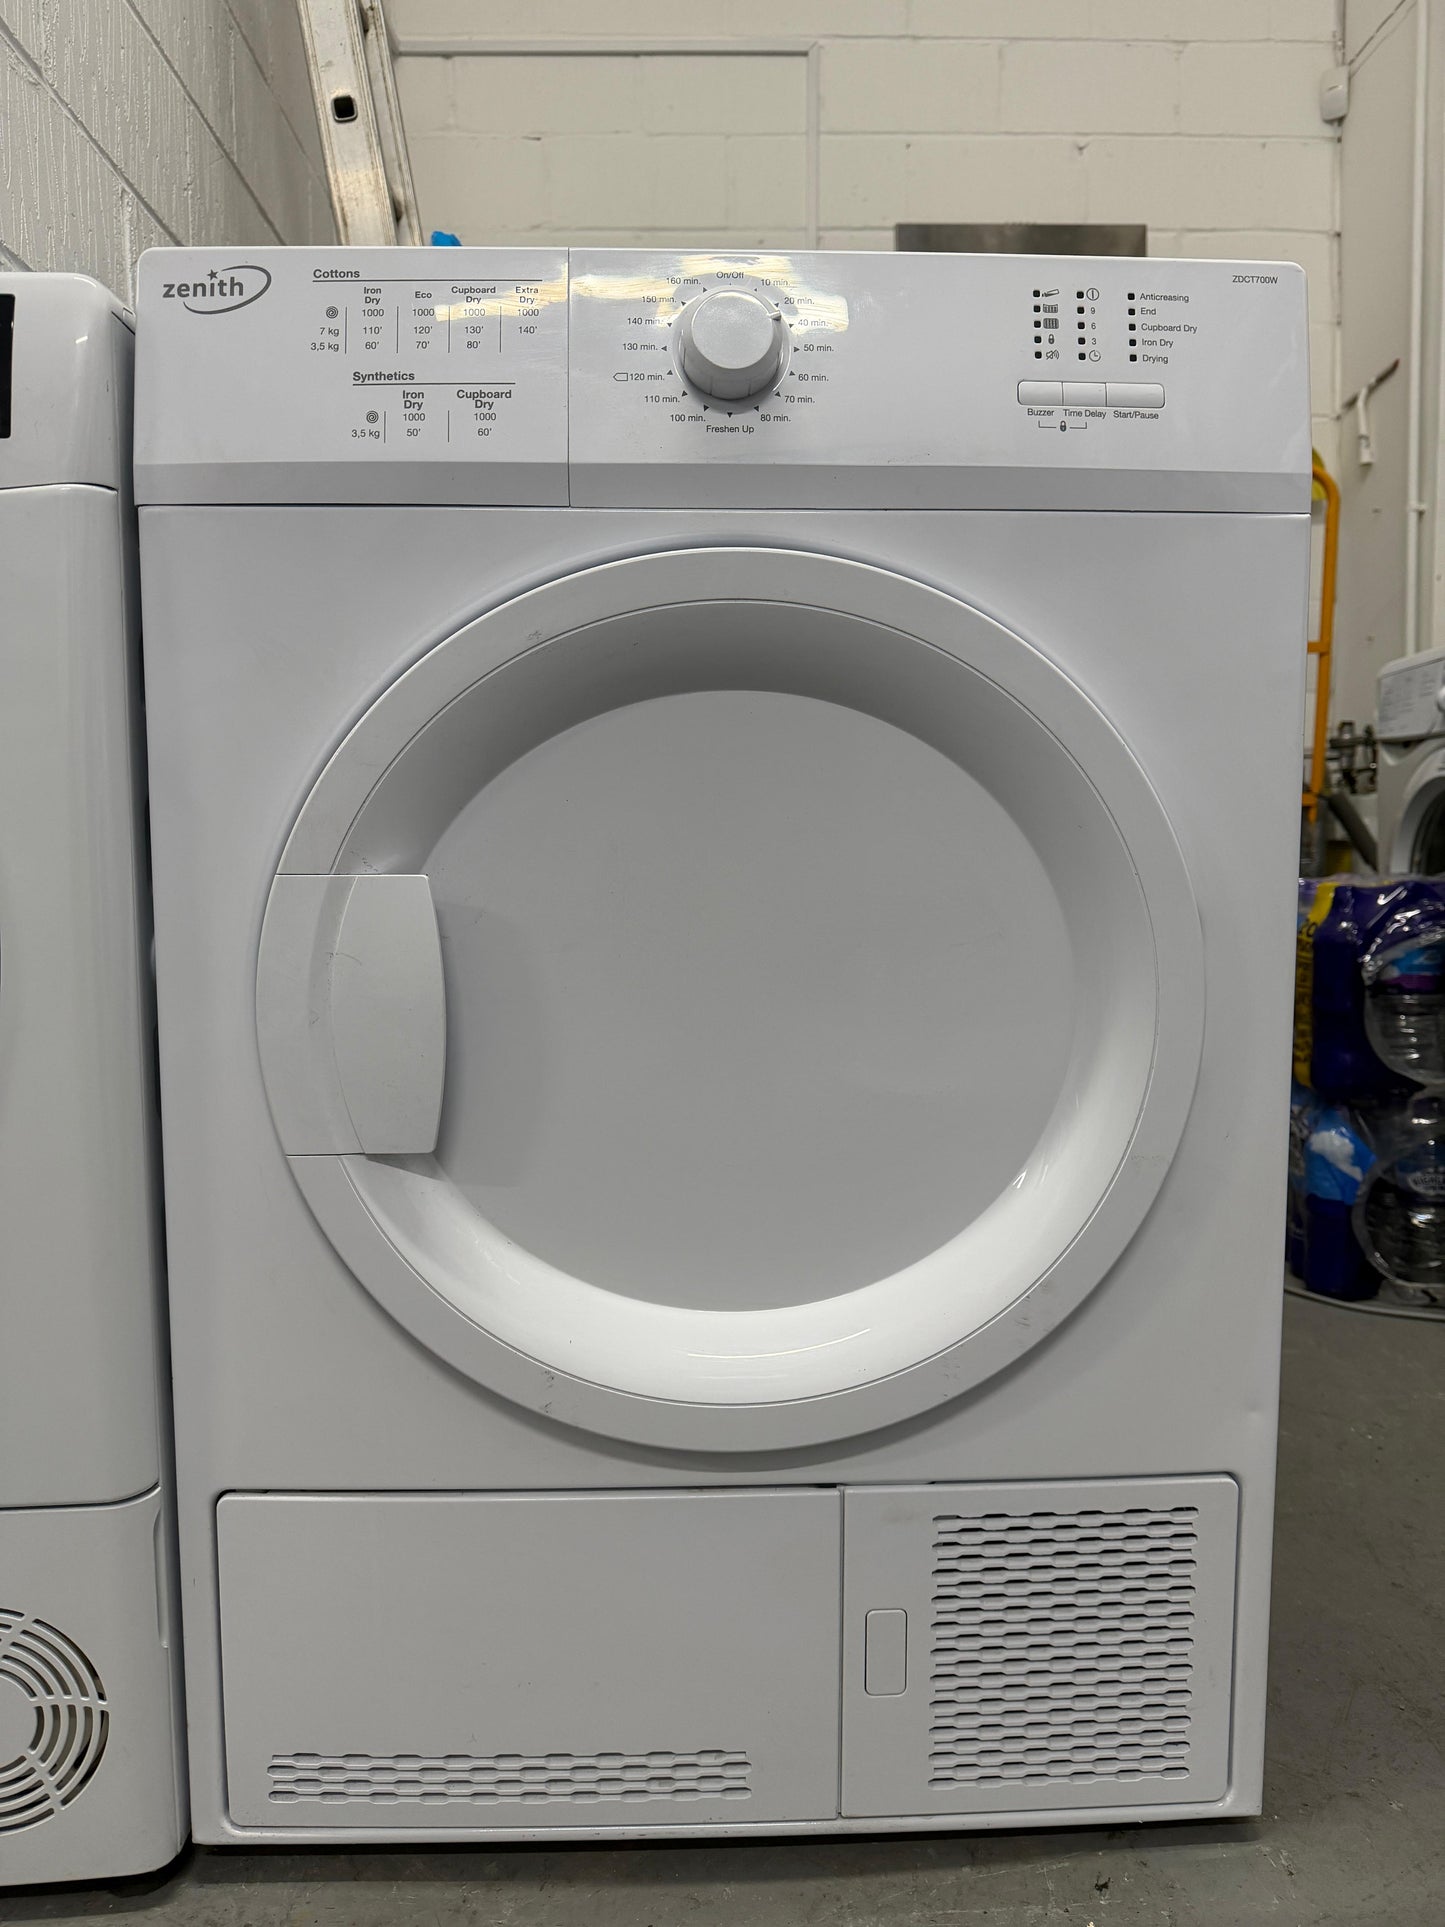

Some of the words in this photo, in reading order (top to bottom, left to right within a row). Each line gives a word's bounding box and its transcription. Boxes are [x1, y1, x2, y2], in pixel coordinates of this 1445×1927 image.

[313, 268, 360, 280] Cottons
[716, 271, 745, 279] On/Off
[666, 277, 682, 285] 160
[683, 277, 702, 285] min.
[773, 279, 791, 287] min.
[1232, 275, 1279, 284] ZDCT700W
[162, 276, 244, 299] zenith
[364, 286, 382, 295] Iron
[451, 286, 497, 296] Cupboard
[515, 286, 539, 295] Extra
[414, 290, 433, 300] Eco
[641, 296, 657, 304] 150
[658, 296, 677, 304] min.
[1140, 293, 1189, 303] Anticreasing
[364, 295, 381, 306] Dry
[465, 295, 482, 306] Dry
[519, 295, 536, 306] Dry
[784, 297, 795, 305] 20
[797, 297, 815, 305] min.
[361, 308, 385, 318] 1000
[412, 308, 435, 318] 1000
[463, 308, 486, 318] 1000
[517, 308, 540, 318] 1000
[644, 318, 662, 326] min.
[798, 319, 809, 327] 40
[811, 319, 829, 327] min.
[1091, 322, 1096, 330] 6
[319, 327, 325, 336] 7
[328, 326, 340, 339] kg
[363, 326, 383, 336] 110'
[413, 325, 434, 335] 120'
[464, 325, 484, 335] 130'
[518, 325, 538, 335] 140'
[1141, 324, 1180, 333] Cupboard
[1182, 324, 1198, 334] Dry
[310, 341, 325, 353] 3,5
[328, 341, 340, 354] kg
[365, 341, 380, 351] 60'
[415, 340, 431, 350] 70'
[466, 340, 481, 350] 80'
[623, 343, 638, 351] 130
[640, 343, 658, 351] min.
[803, 344, 814, 352] 50
[816, 344, 835, 352] min.
[1142, 339, 1158, 347] Iron
[1160, 339, 1174, 348] Dry
[1142, 354, 1169, 364] Drying
[352, 371, 416, 384] Synthetics
[629, 373, 645, 381] 120
[647, 373, 665, 381] min.
[798, 374, 810, 382] 60
[811, 374, 829, 382] min.
[402, 390, 425, 400] Iron
[456, 389, 513, 402] Cupboard
[644, 395, 660, 403] 110
[662, 395, 681, 403] min.
[784, 396, 795, 404] 70
[797, 396, 815, 404] min.
[403, 400, 424, 412] Dry
[474, 399, 494, 412] Dry
[402, 412, 426, 423] 1000
[473, 412, 497, 422] 1000
[1027, 409, 1055, 417] Buzzer
[1063, 409, 1083, 418] Time
[1085, 410, 1107, 419] Delay
[1113, 411, 1159, 420] Start/Pause
[670, 414, 685, 423] 100
[687, 414, 706, 423] min.
[760, 414, 772, 422] 80
[773, 414, 791, 423] min.
[351, 429, 366, 440] 3,5
[369, 428, 381, 441] kg
[406, 428, 422, 438] 50'
[477, 428, 493, 438] 60'
[706, 425, 740, 434] Freshen
[742, 425, 755, 436] Up
